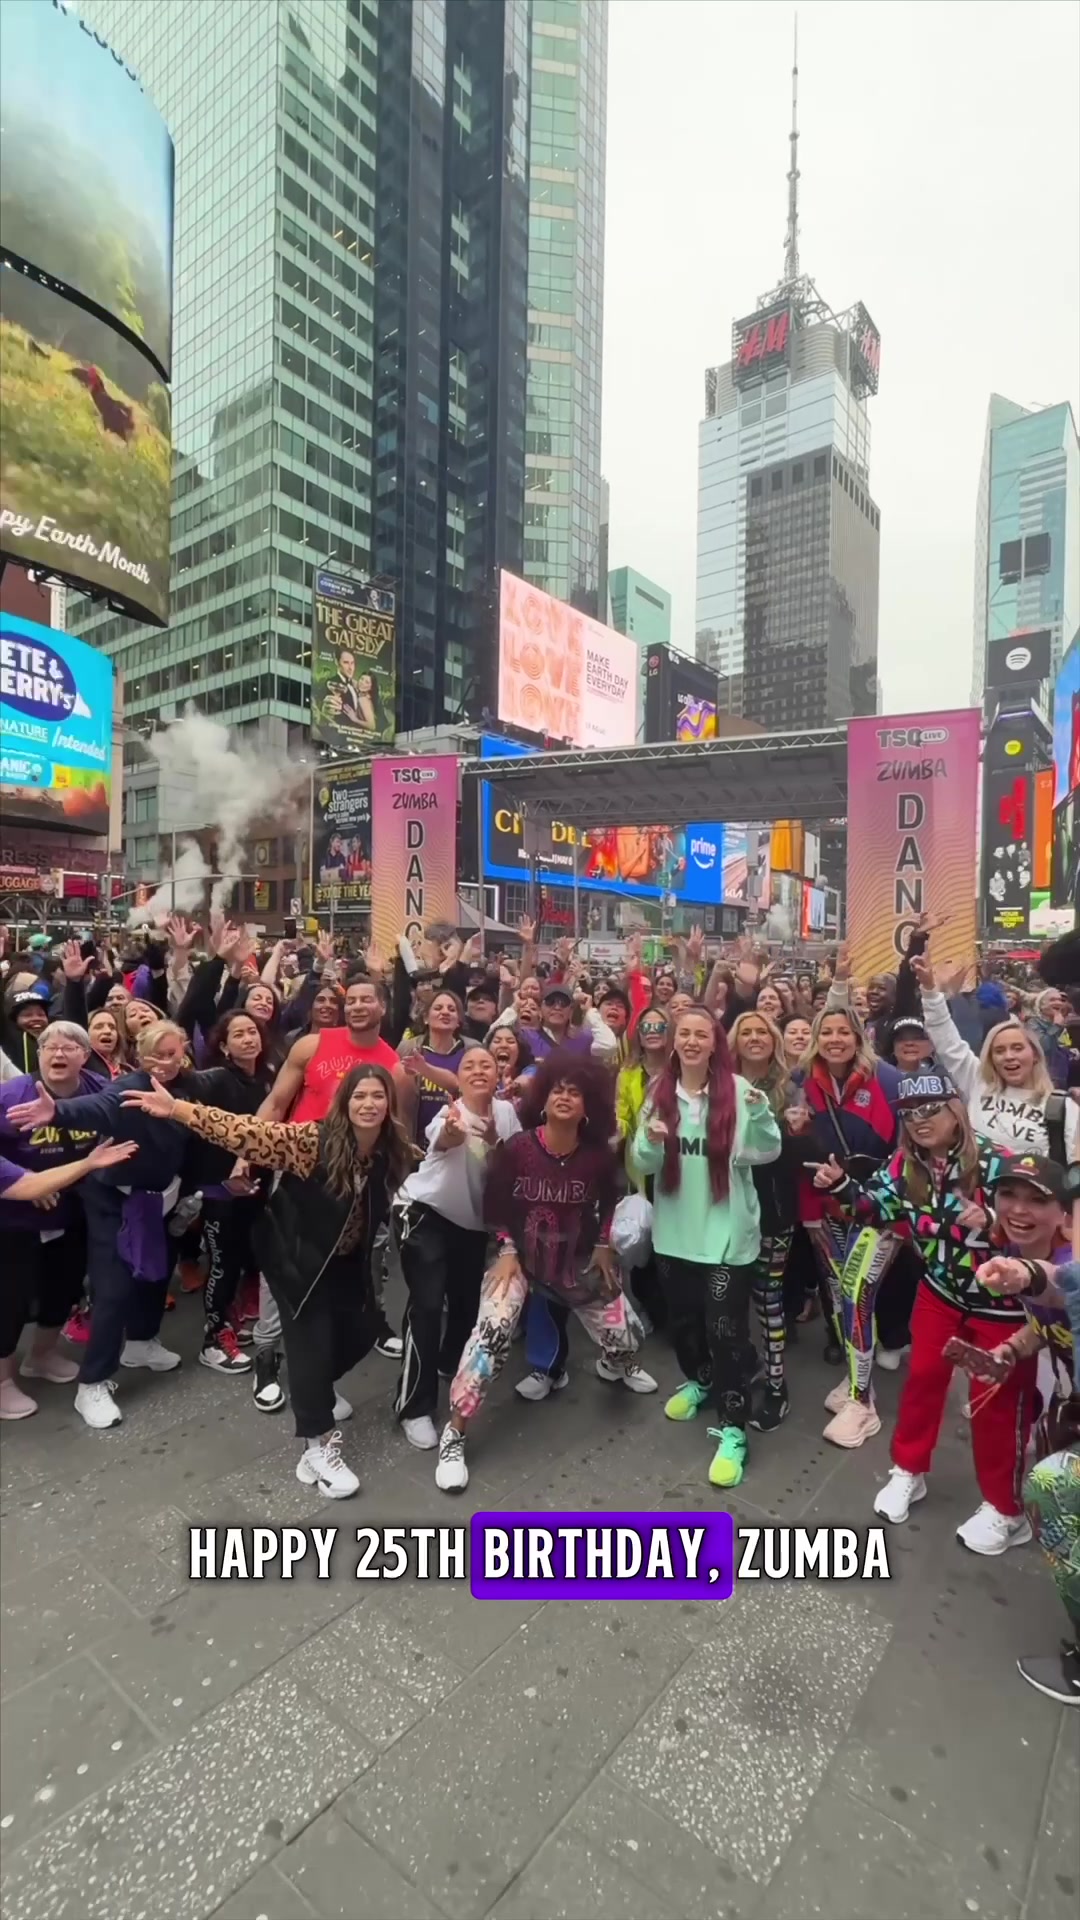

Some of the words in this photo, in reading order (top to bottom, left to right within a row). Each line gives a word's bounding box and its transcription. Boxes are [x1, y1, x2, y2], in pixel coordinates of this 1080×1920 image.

[735, 311, 790, 368] H&M
[34, 515, 98, 557] Earth
[96, 540, 151, 585] Month
[315, 602, 343, 628] THE
[345, 613, 395, 642] GREAT
[325, 626, 386, 656] GATSBY
[48, 658, 64, 680] &
[586, 649, 611, 670] MAKE
[586, 661, 613, 683] EARTH
[613, 674, 629, 690] DAY
[648, 668, 659, 677] LG
[586, 673, 626, 699] EVERYDAY
[877, 728, 922, 748] TSQ
[923, 732, 943, 740] LIVE
[392, 768, 422, 782] TSQ
[876, 758, 948, 782] ZUMBA
[328, 796, 369, 813] strangers
[332, 789, 348, 801] two
[392, 792, 438, 809] ZUMBA
[690, 837, 717, 857] prime
[344, 885, 358, 898] THE
